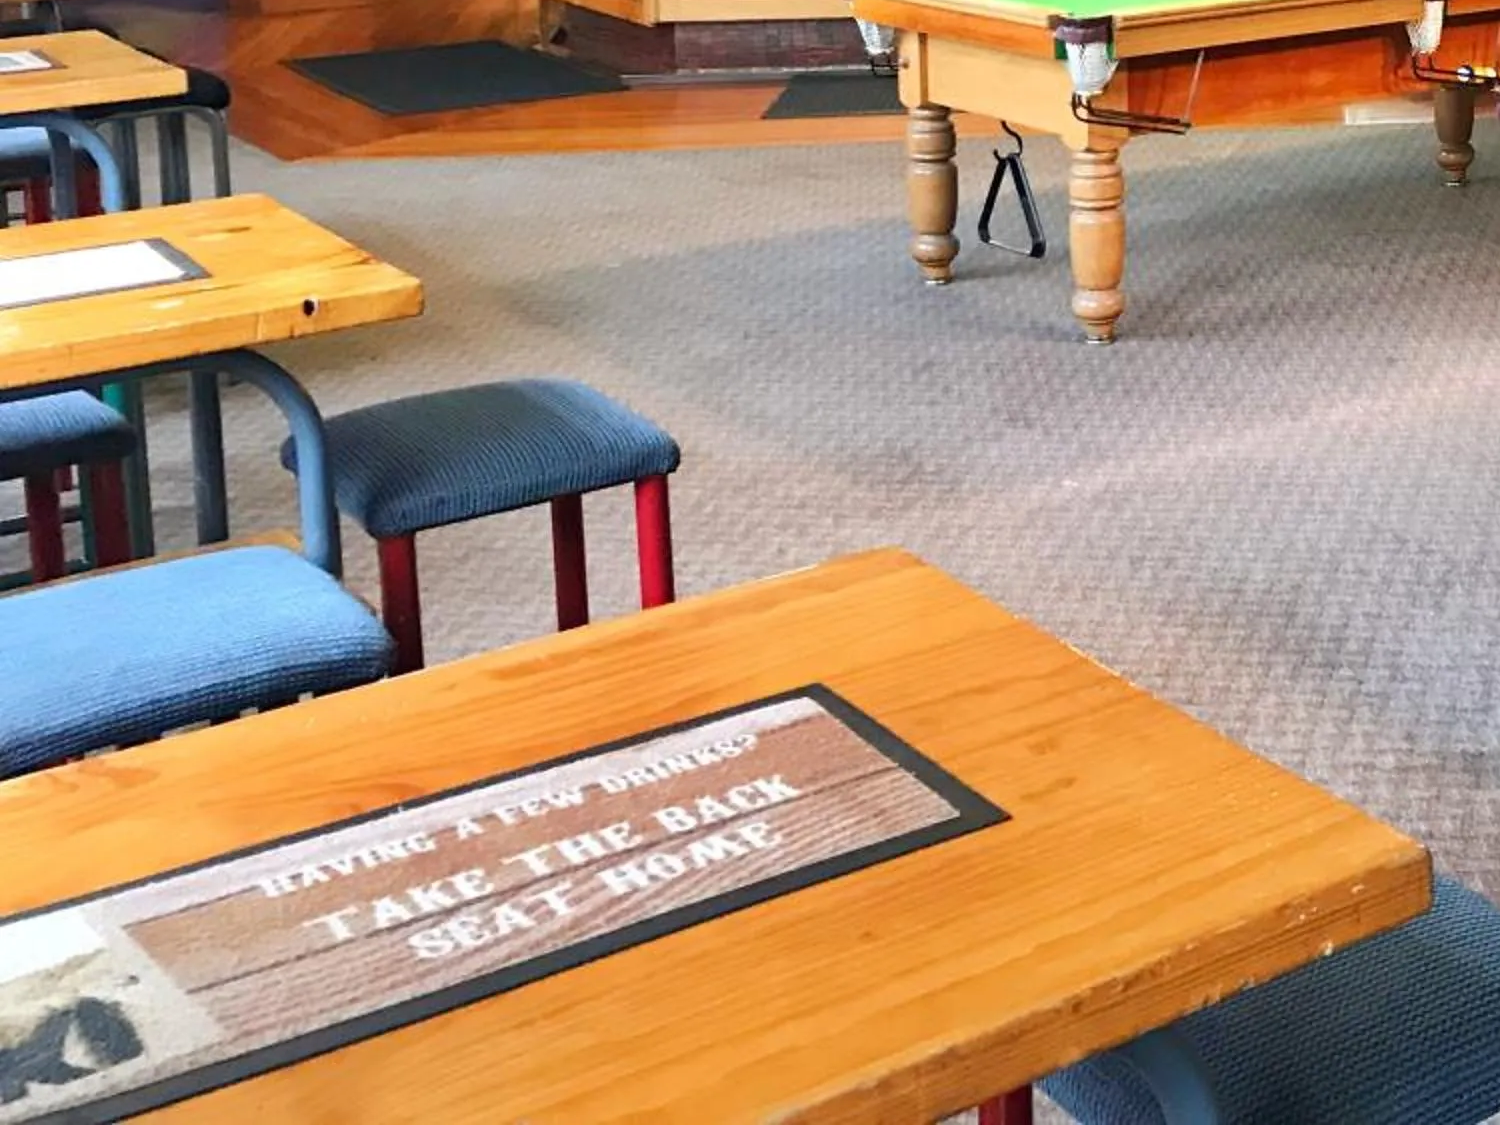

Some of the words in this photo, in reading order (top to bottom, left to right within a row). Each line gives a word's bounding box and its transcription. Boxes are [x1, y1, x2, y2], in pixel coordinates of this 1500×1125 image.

[258, 832, 437, 897] HAVING
[454, 817, 485, 840] A
[491, 785, 585, 825] FEW
[599, 733, 759, 794] DRINKS?
[301, 868, 496, 941] TAKE
[499, 821, 644, 876] THE
[652, 774, 801, 833] BACK
[407, 880, 576, 958] SEAT
[596, 821, 784, 896] HOME
